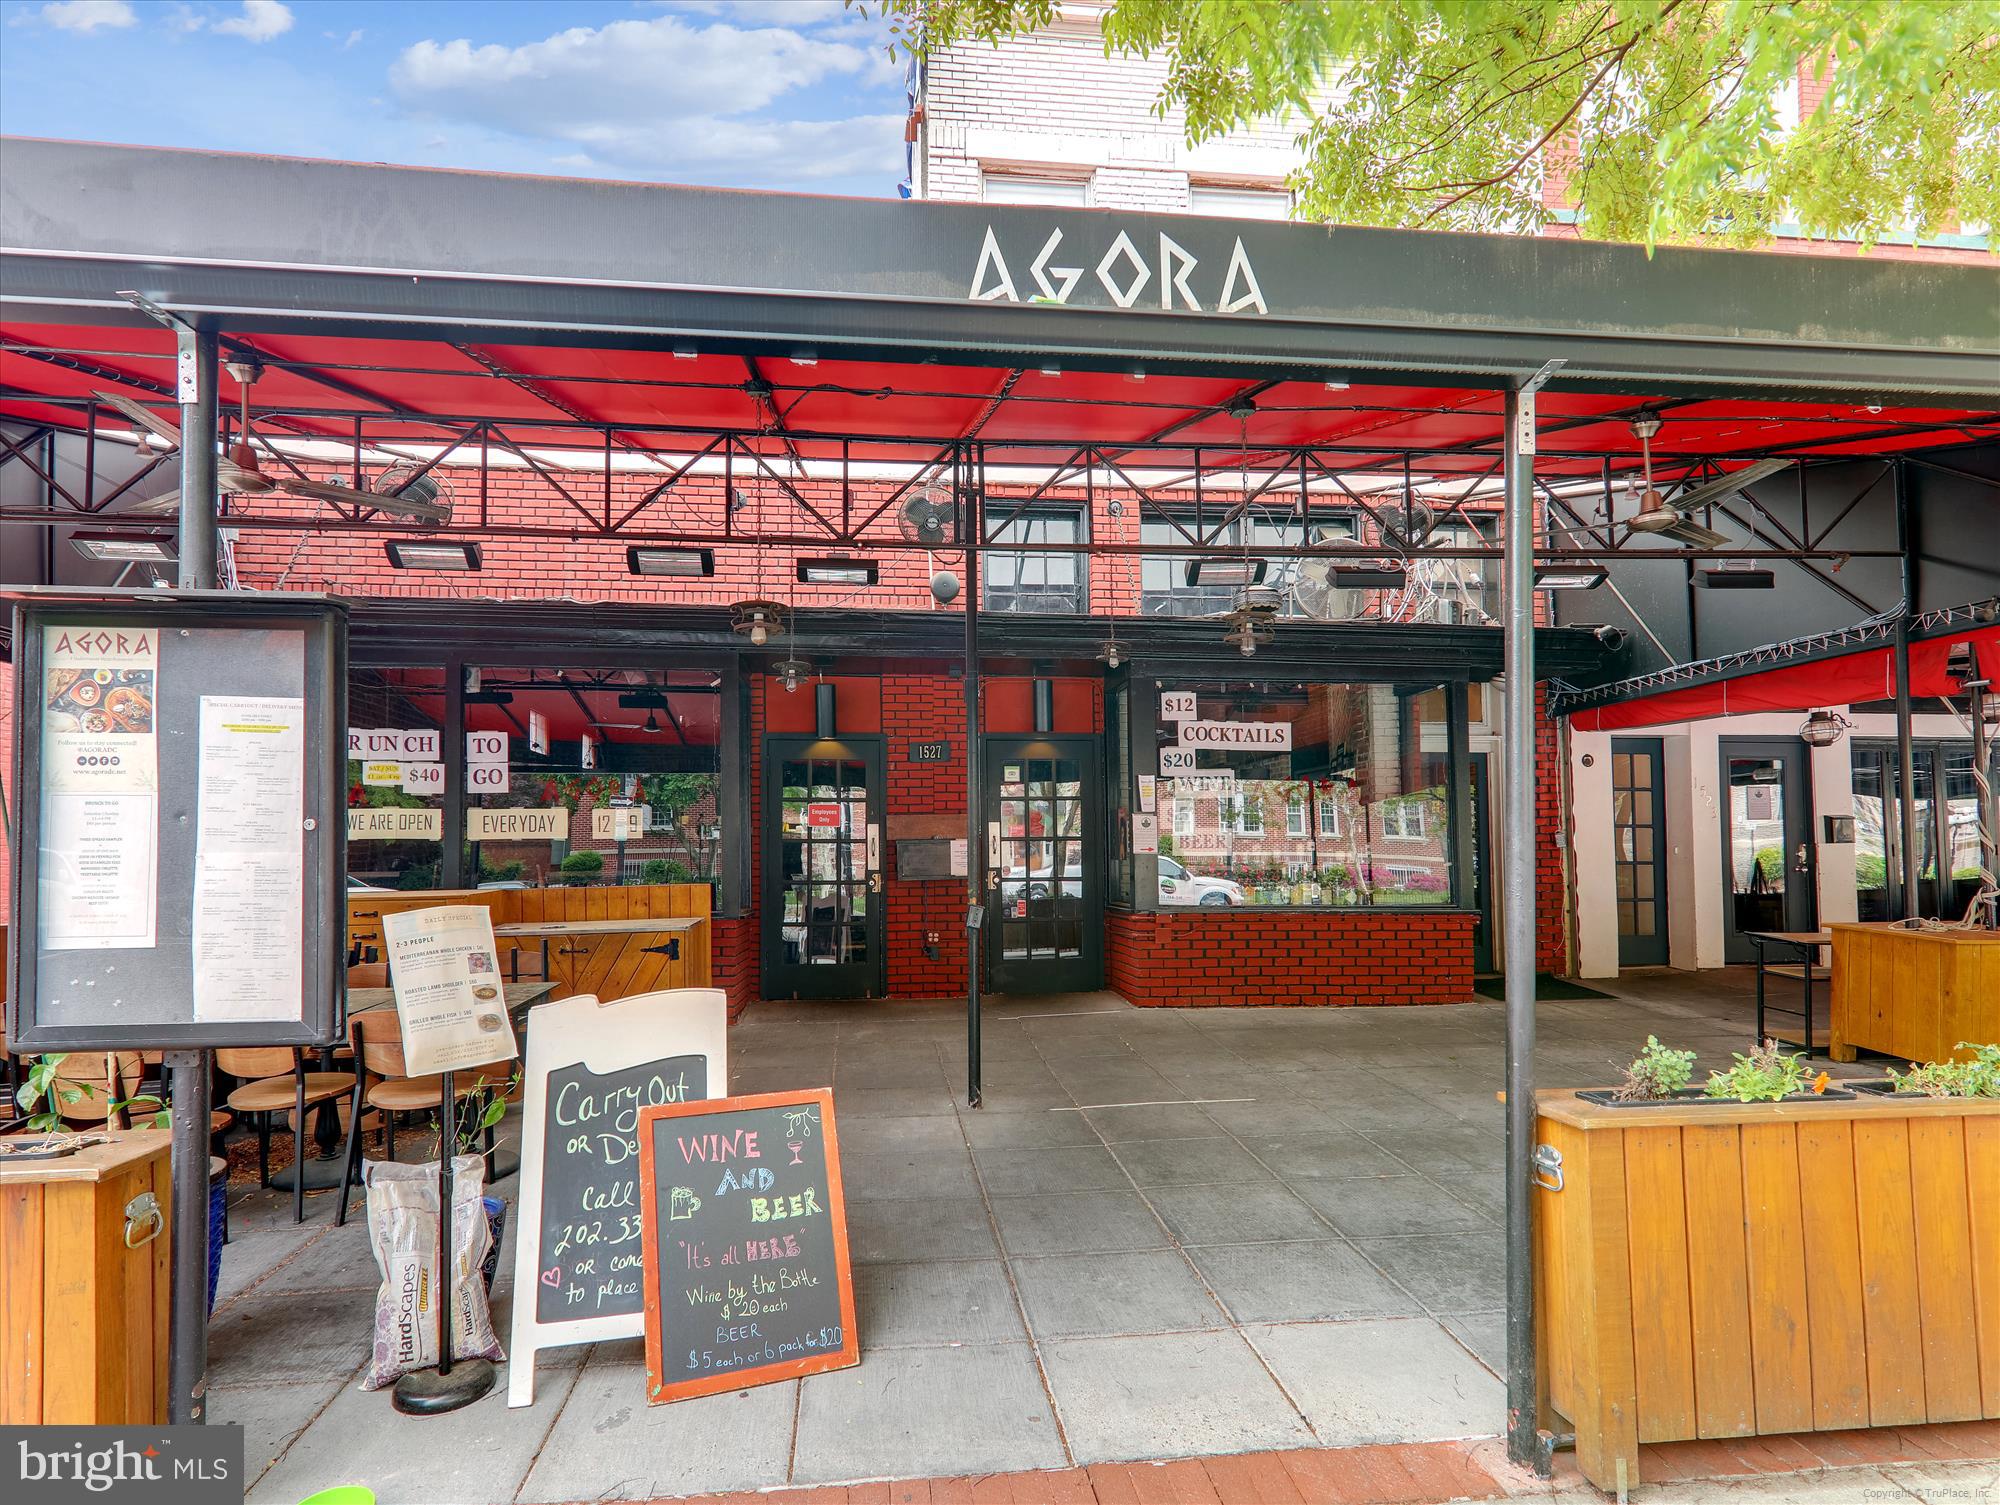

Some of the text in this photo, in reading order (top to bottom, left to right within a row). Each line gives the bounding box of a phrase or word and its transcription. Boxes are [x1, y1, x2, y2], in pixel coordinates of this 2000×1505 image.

[968, 224, 1269, 315] AGORA
[54, 631, 151, 655] AGORA
[1165, 698, 1195, 715] $12
[348, 735, 434, 753] RUNCH
[1183, 726, 1285, 744] COCKTAILS
[473, 738, 502, 754] TO
[919, 745, 942, 759] 1527
[1163, 752, 1193, 770] $20
[73, 768, 126, 776] www.agoradc.net
[409, 768, 440, 784] $40
[473, 768, 503, 784] GO
[812, 808, 838, 816] Employees
[369, 814, 393, 830] ARE
[399, 814, 433, 831] OPEN
[483, 815, 555, 833] EVERYDAY
[598, 815, 610, 832] 12
[630, 815, 638, 832] 9
[424, 914, 473, 924] DAILY SPECIAL
[410, 936, 434, 946] PEOPLE
[427, 983, 441, 991] LAMB
[555, 1072, 689, 1132] Carry Out
[567, 1133, 640, 1164] OR De
[678, 1129, 761, 1165] WINE
[715, 1168, 775, 1196] AND
[582, 1181, 635, 1211] Call
[751, 1187, 823, 1222] BEER
[555, 1216, 642, 1256] 202.33
[575, 1253, 644, 1275] OR come
[721, 1246, 741, 1265] all
[565, 1280, 639, 1309] to place
[686, 1268, 821, 1306] Wine by the Bottle
[399, 1263, 417, 1364] HardScapes
[459, 1287, 474, 1336] HardScap
[763, 1299, 788, 1313] each
[716, 1323, 762, 1344] BEER
[716, 1352, 743, 1367] each
[748, 1351, 760, 1363] or
[764, 1341, 774, 1359] 6
[778, 1337, 804, 1359] pack
[805, 1331, 818, 1347] for
[819, 1326, 843, 1349] $20
